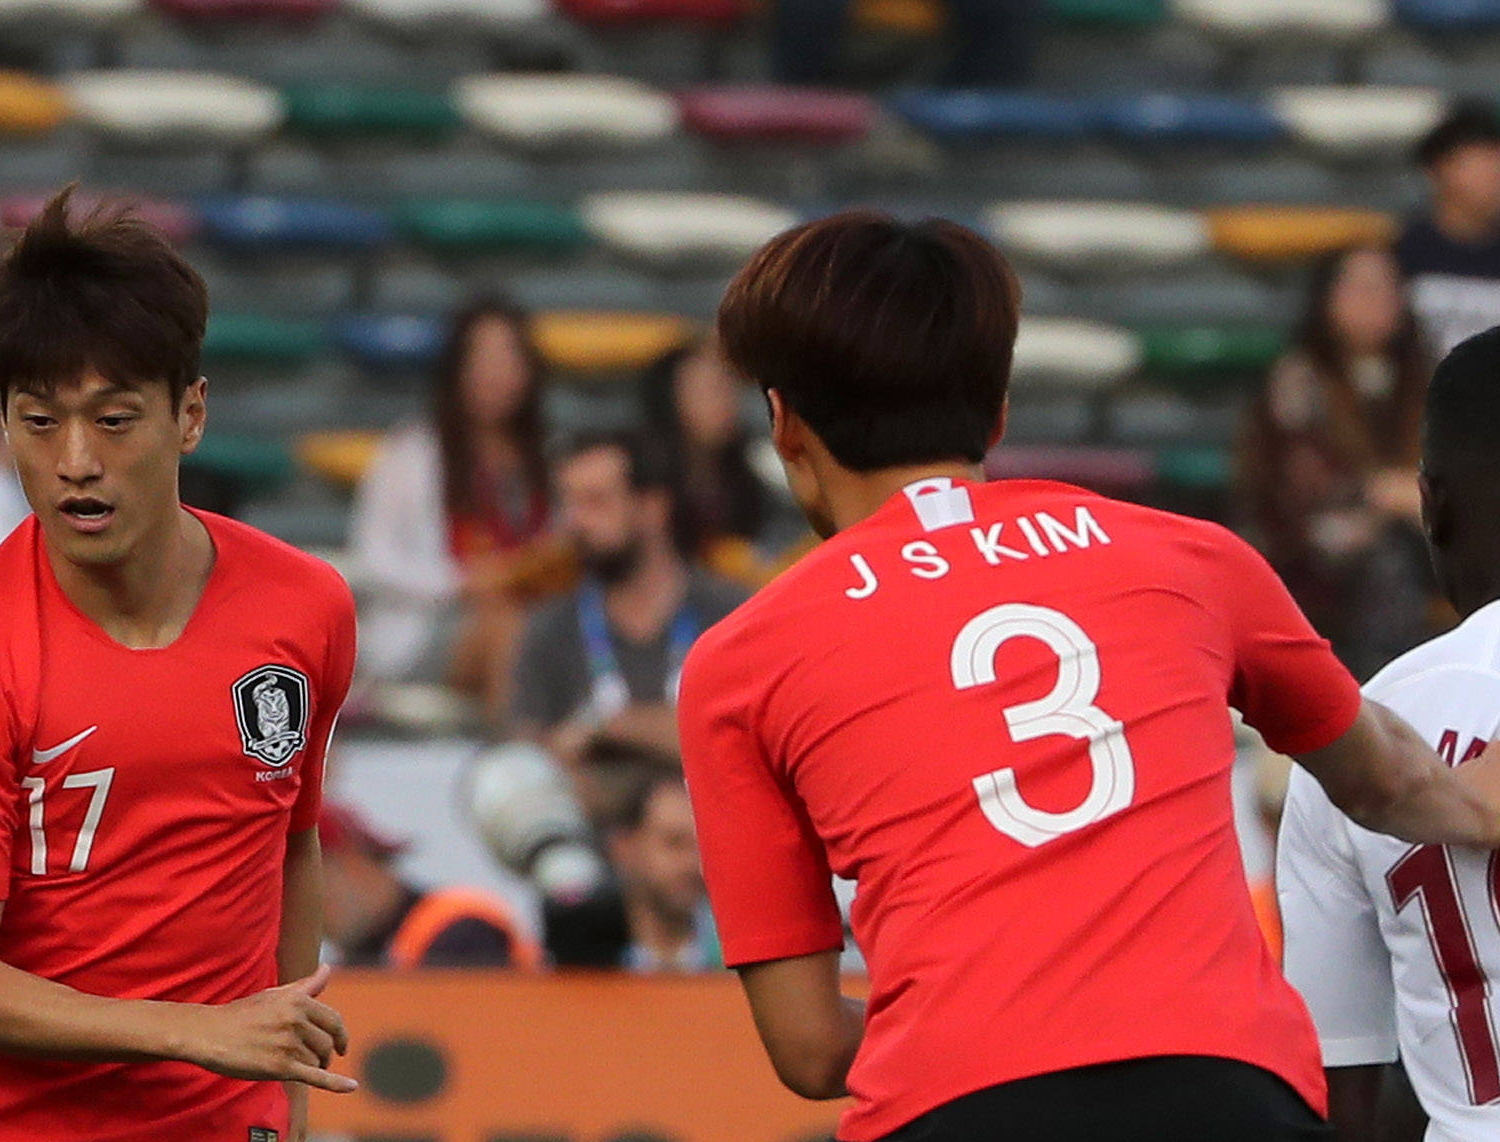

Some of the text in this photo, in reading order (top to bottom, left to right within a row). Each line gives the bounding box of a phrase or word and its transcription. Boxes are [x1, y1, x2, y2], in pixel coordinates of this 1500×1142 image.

[844, 505, 1111, 600] J S KIM
[950, 602, 1135, 848] 3
[21, 766, 115, 876] 17
[1385, 842, 1500, 1106] 1
